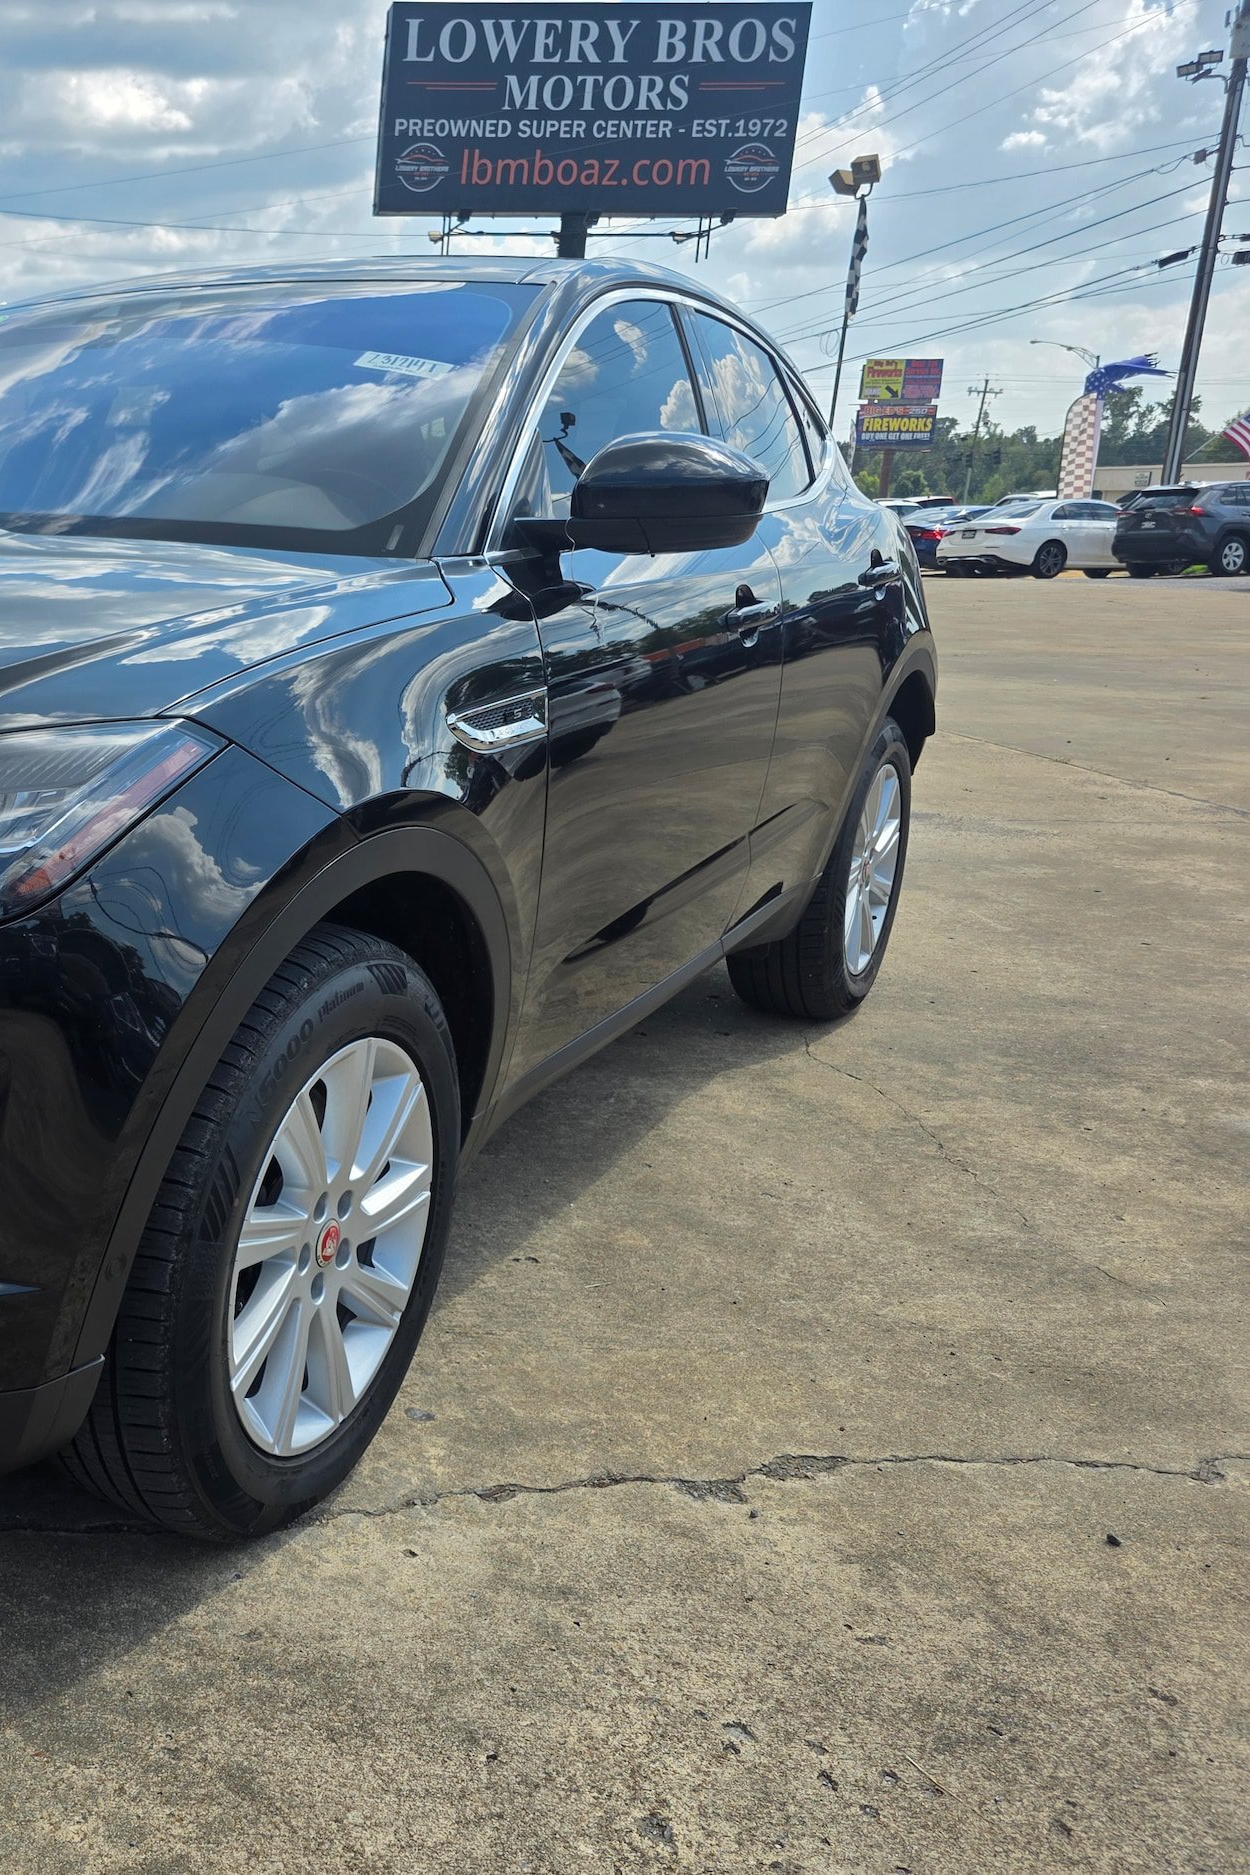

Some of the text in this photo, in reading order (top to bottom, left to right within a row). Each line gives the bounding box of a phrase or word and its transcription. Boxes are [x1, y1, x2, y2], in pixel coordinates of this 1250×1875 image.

[403, 18, 798, 64] LOWERY BROS
[502, 74, 690, 112] MOTORS
[394, 119, 512, 138] PREOWNED
[517, 119, 586, 139] SUPER
[592, 120, 671, 139] CENTER
[691, 119, 788, 138] EST.1972
[459, 149, 710, 187] lbmboaz.com
[861, 432, 874, 440] BUY
[875, 432, 888, 441] ONE
[888, 432, 900, 441] GET
[900, 432, 913, 441] ONE
[863, 418, 932, 431] FIREWORKS
